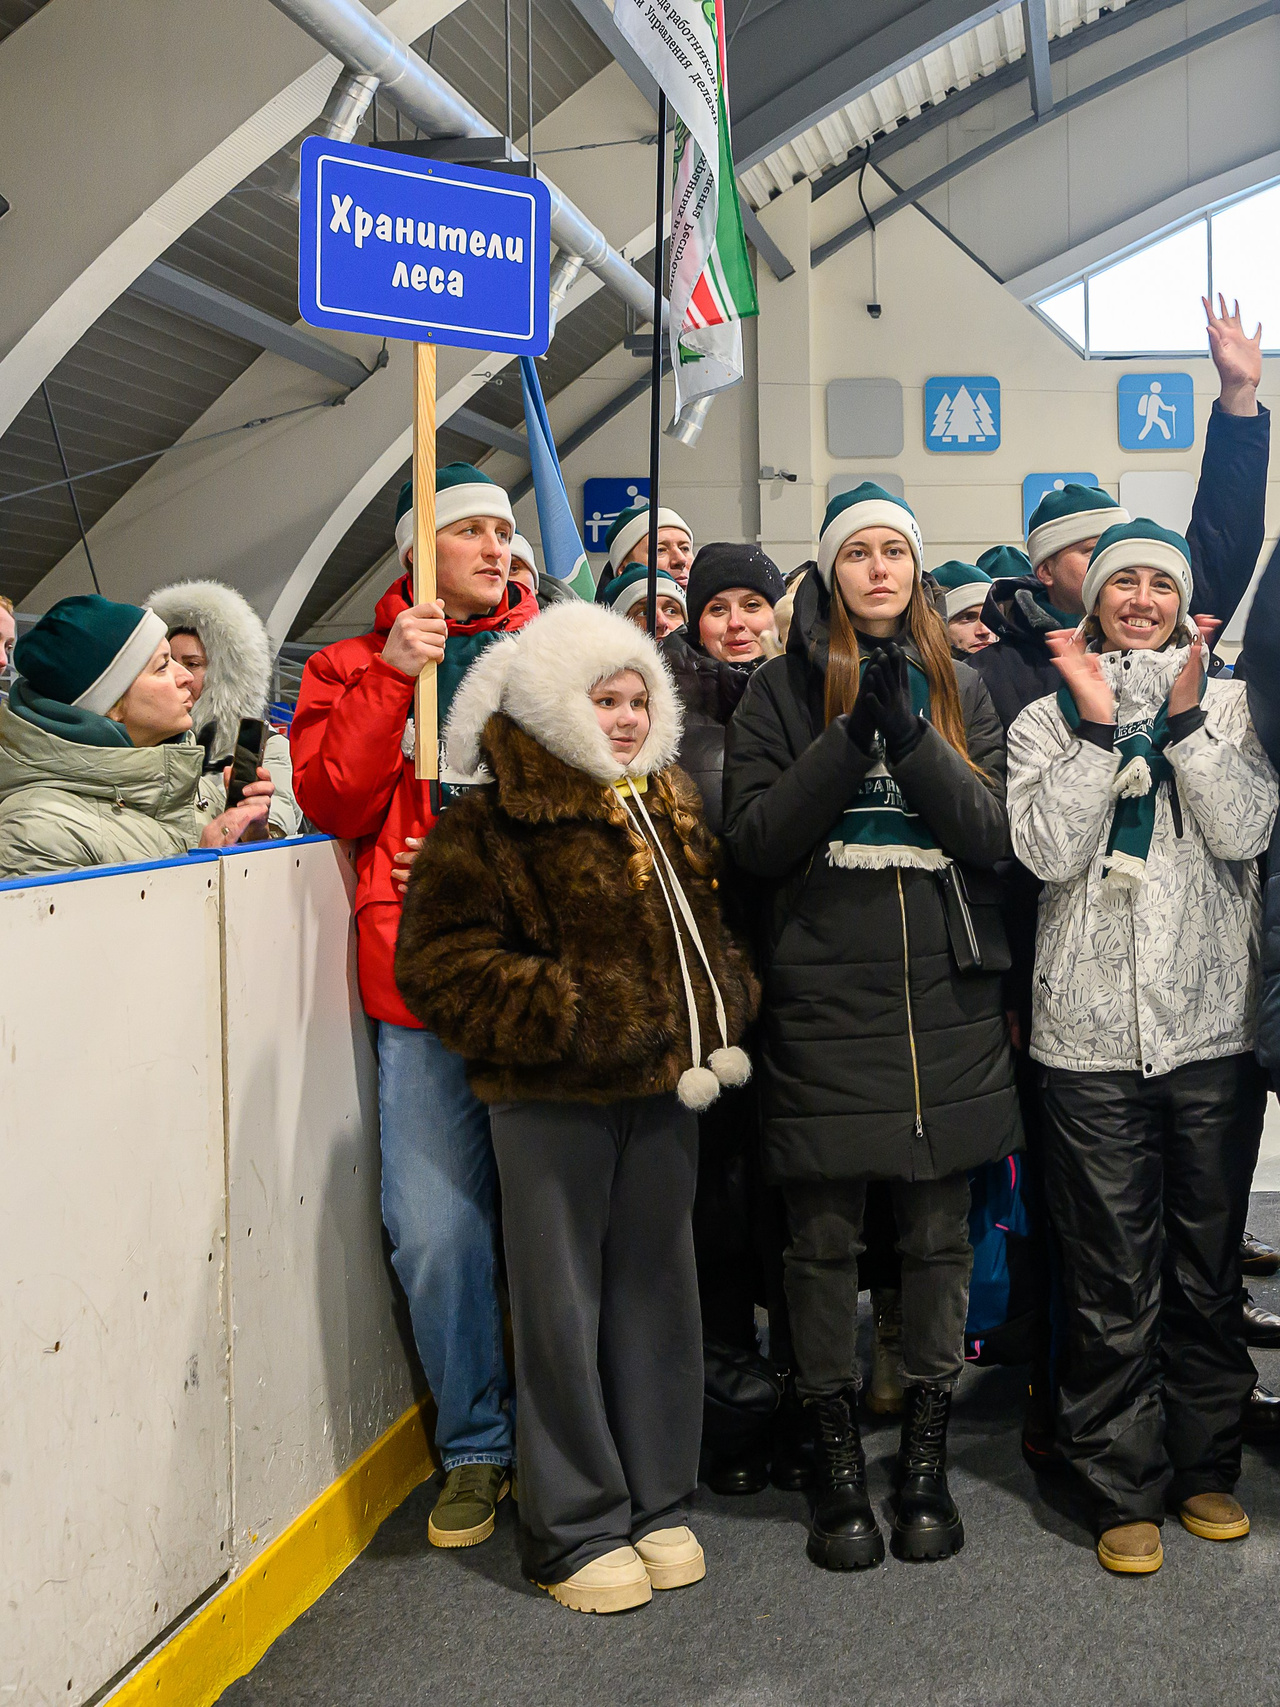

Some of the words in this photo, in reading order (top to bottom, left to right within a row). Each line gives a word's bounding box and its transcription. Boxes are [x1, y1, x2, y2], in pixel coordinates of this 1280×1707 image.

[644, 4, 694, 70] Управления
[688, 72, 718, 126] делами
[665, 9, 717, 85] работников
[329, 194, 524, 264] Хранители
[391, 261, 464, 298] леса
